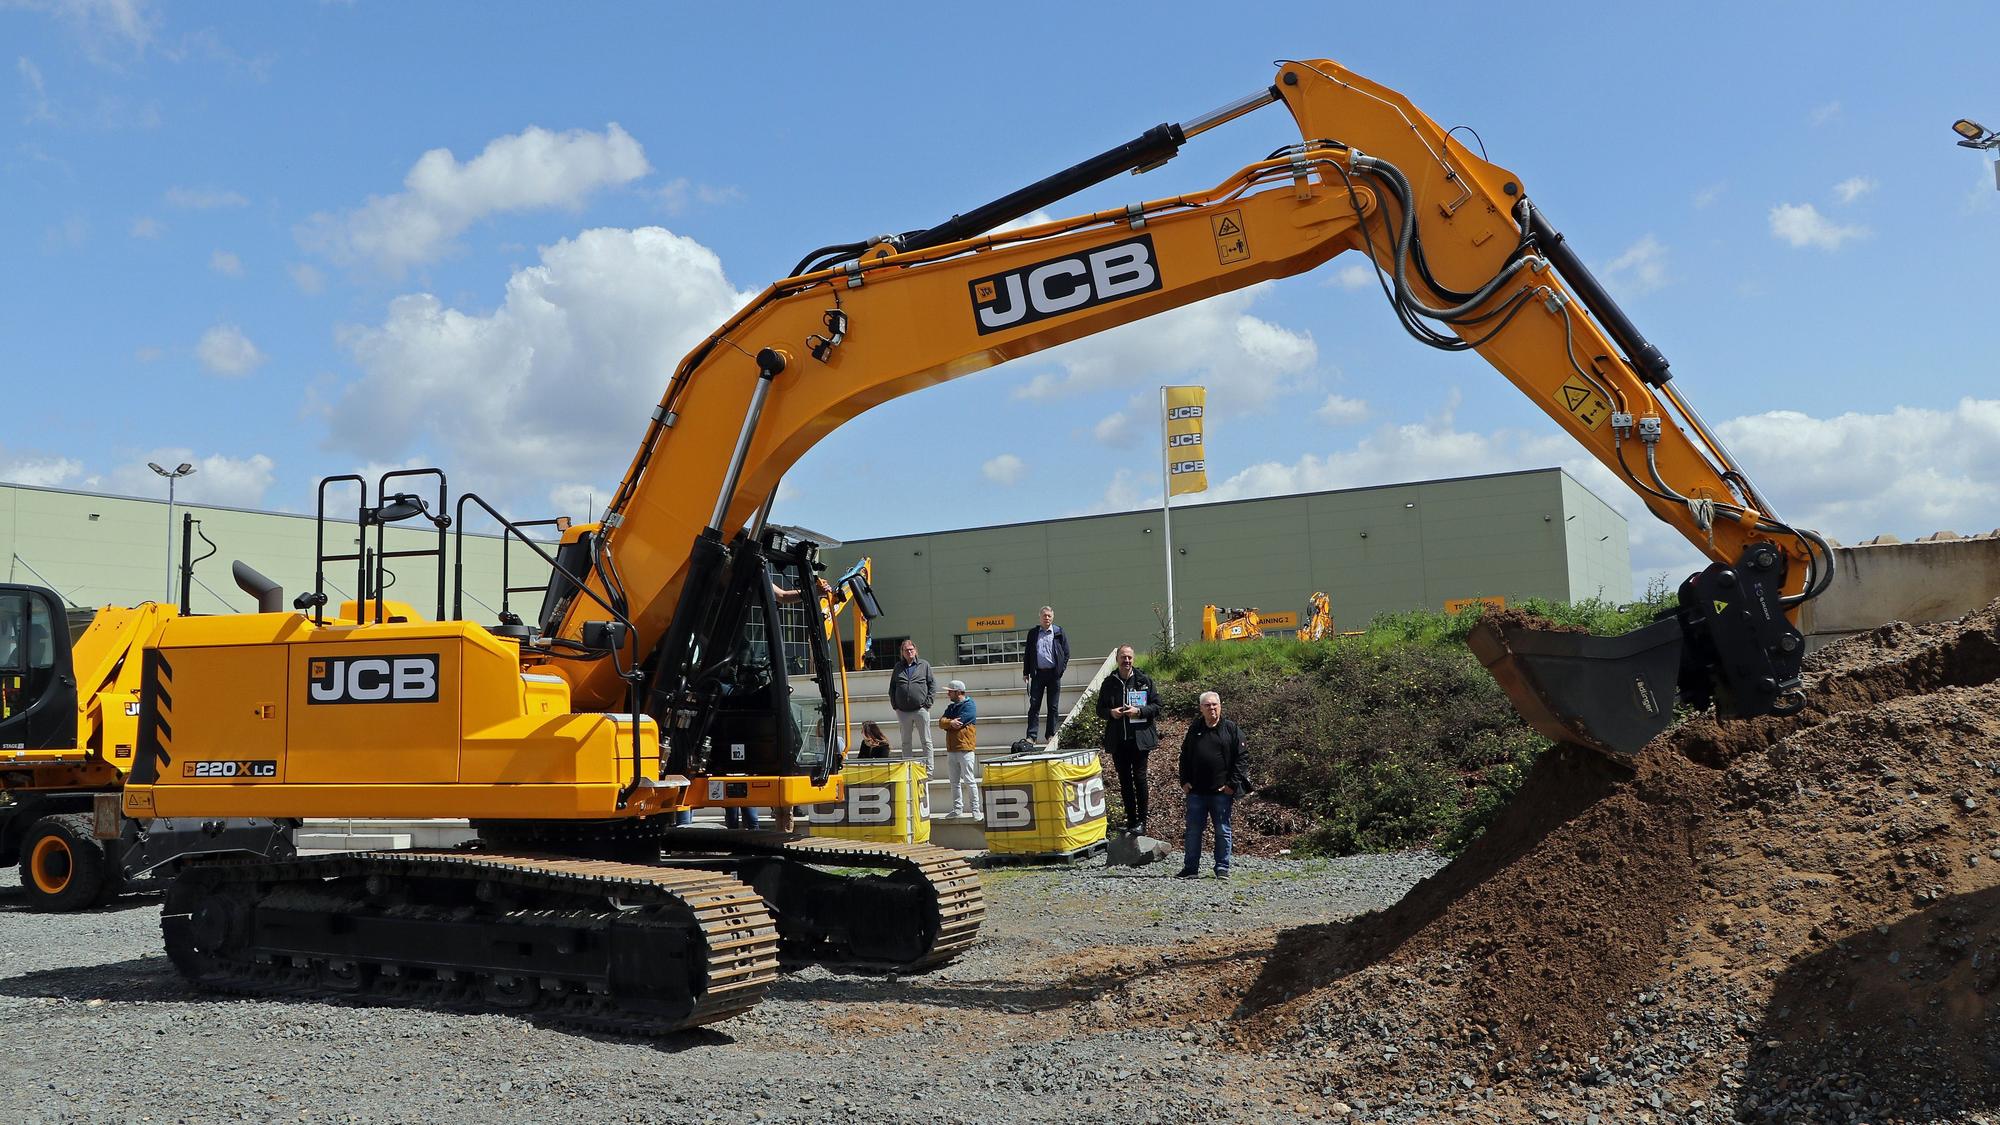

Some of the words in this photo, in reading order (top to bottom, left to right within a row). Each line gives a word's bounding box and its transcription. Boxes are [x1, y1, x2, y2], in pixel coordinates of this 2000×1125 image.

[979, 242, 1155, 327] JCB
[1169, 407, 1202, 420] JCB
[1172, 461, 1205, 474] JCB
[312, 658, 436, 700] JCB
